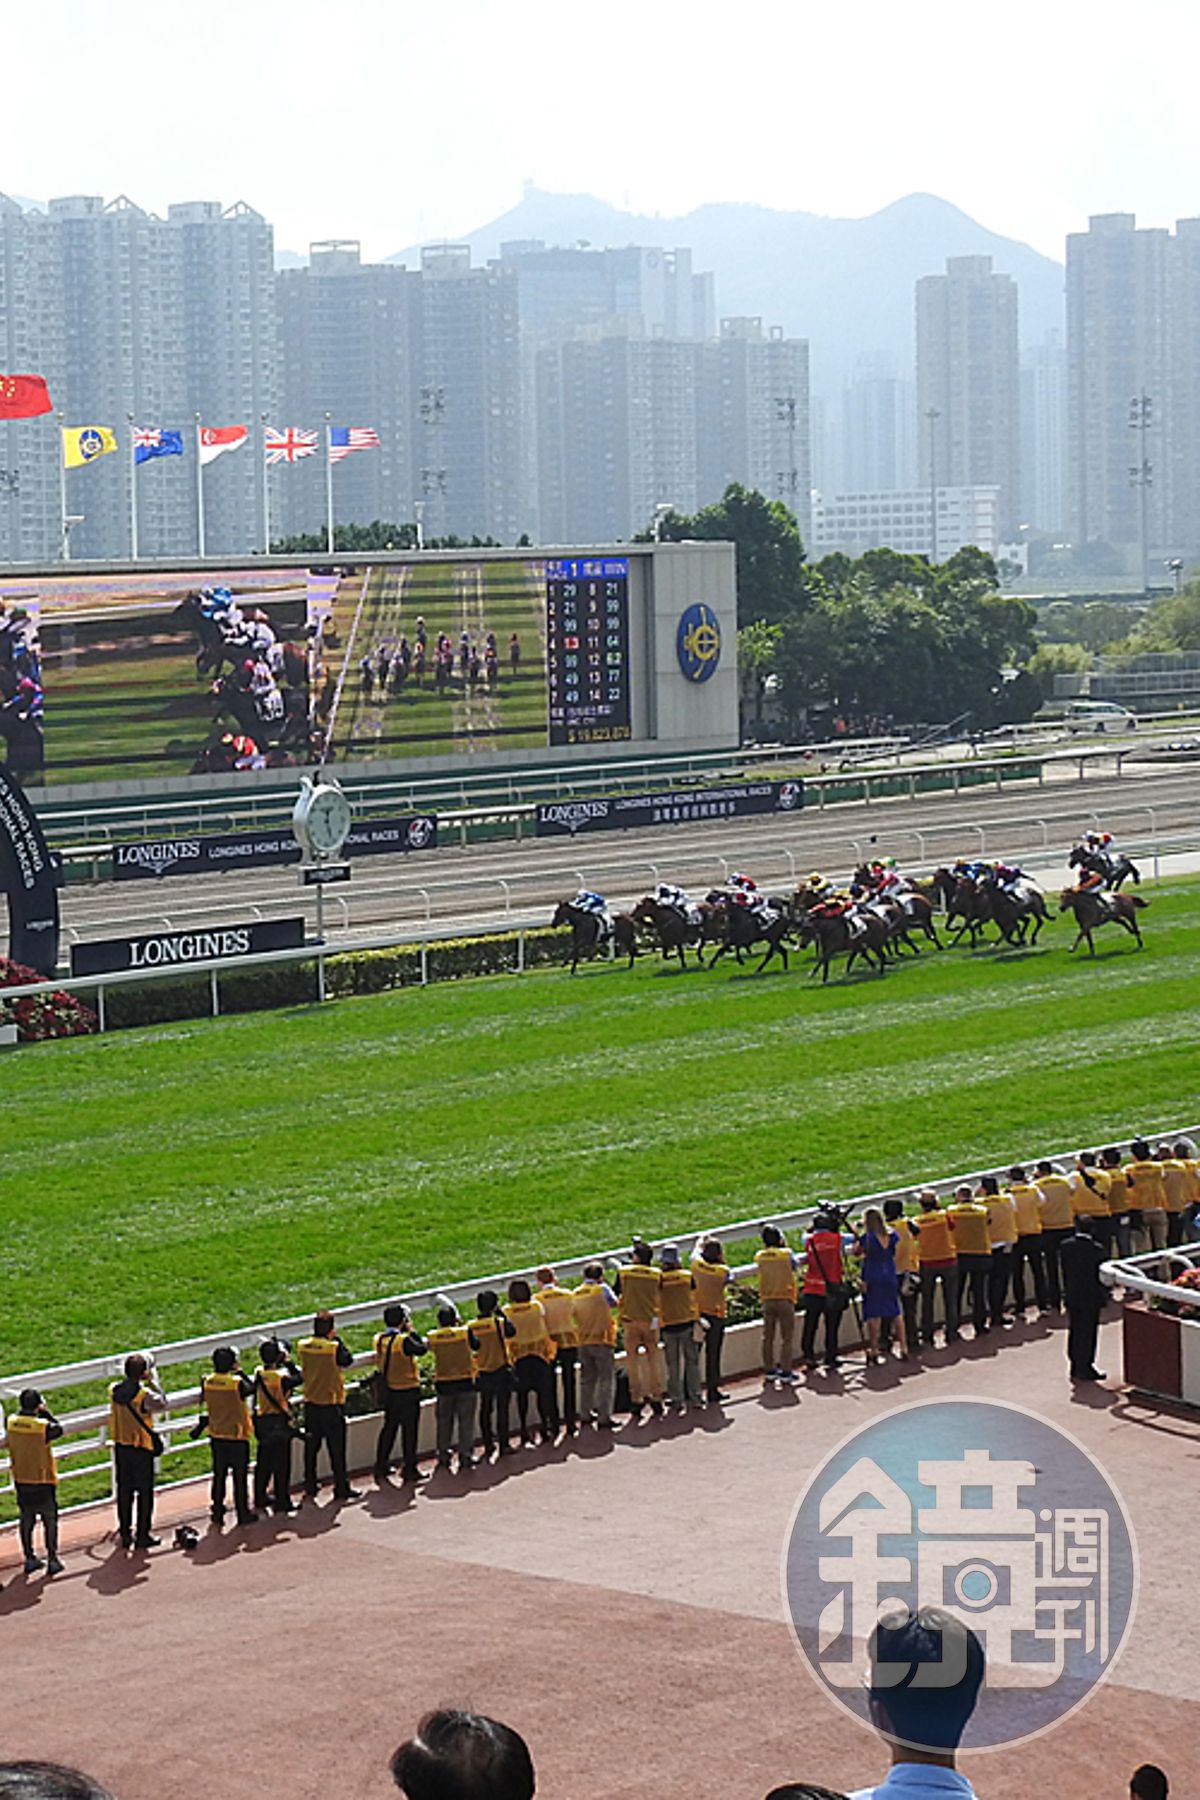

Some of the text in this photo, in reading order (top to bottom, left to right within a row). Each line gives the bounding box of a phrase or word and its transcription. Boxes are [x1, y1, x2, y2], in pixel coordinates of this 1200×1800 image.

[540, 801, 609, 822] LONGINES
[118, 841, 200, 865] LONGINES
[281, 839, 300, 851] KON
[129, 928, 251, 967] LONGINES
